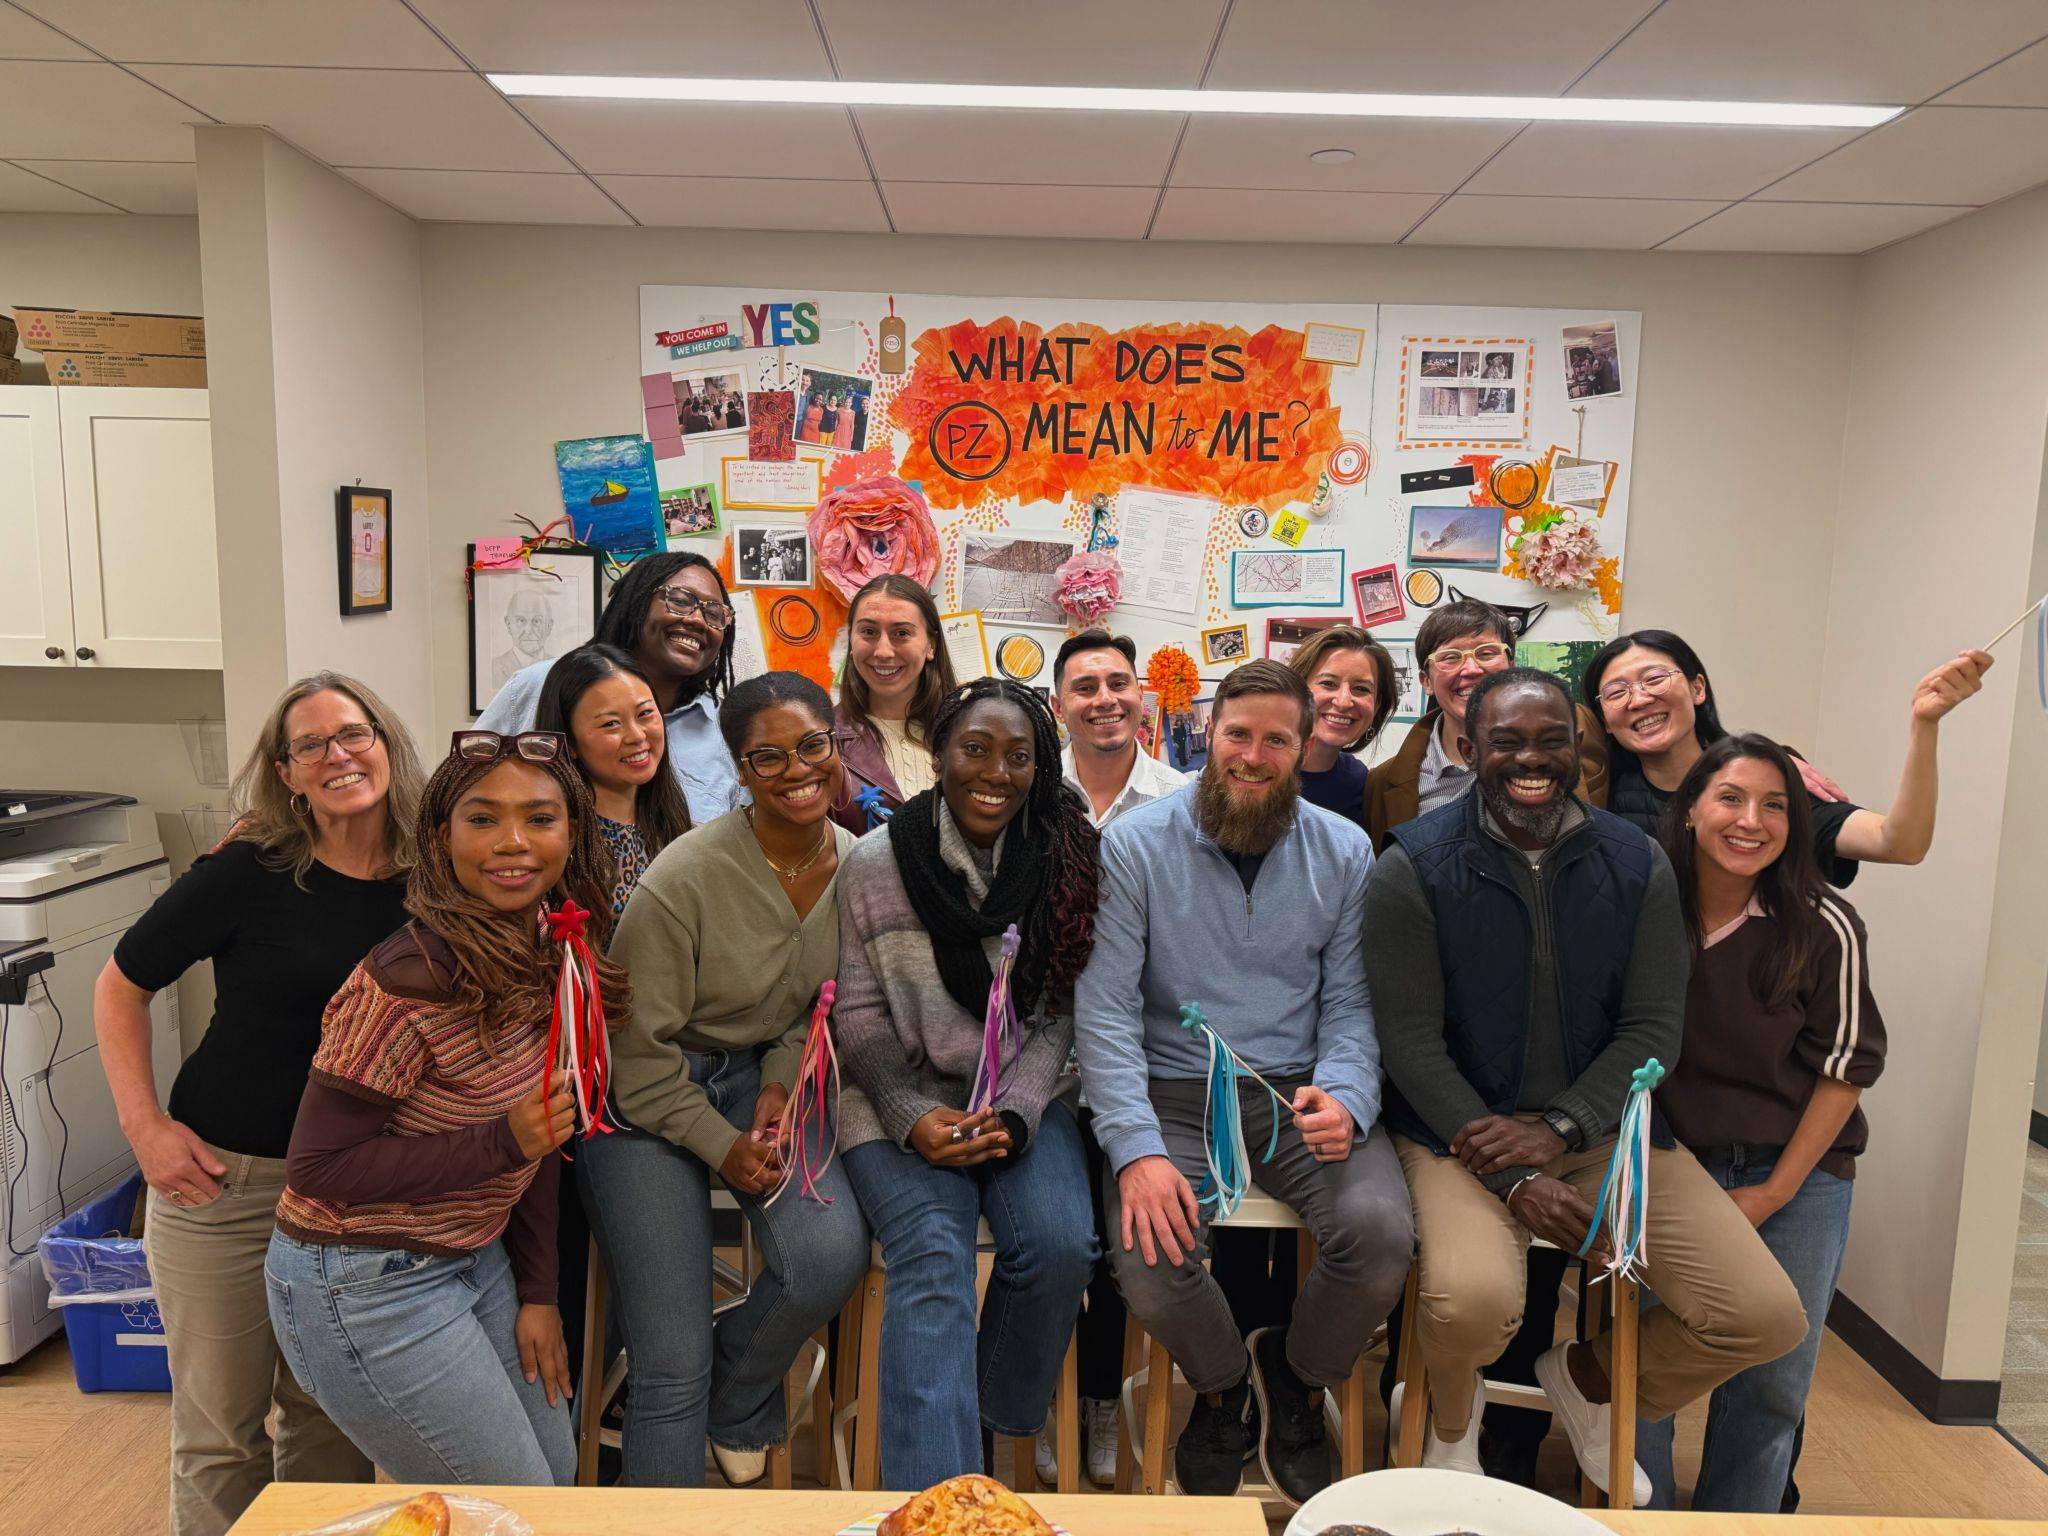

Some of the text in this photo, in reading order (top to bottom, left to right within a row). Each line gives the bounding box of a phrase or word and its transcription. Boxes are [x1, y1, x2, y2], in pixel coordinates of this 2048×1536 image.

[665, 324, 726, 344] YOU COME IN
[677, 338, 731, 356] WE HELP OUT
[742, 302, 820, 347] YES
[949, 336, 1245, 385] WHAT DOES
[947, 401, 1311, 462] PZ MEAN to ME?
